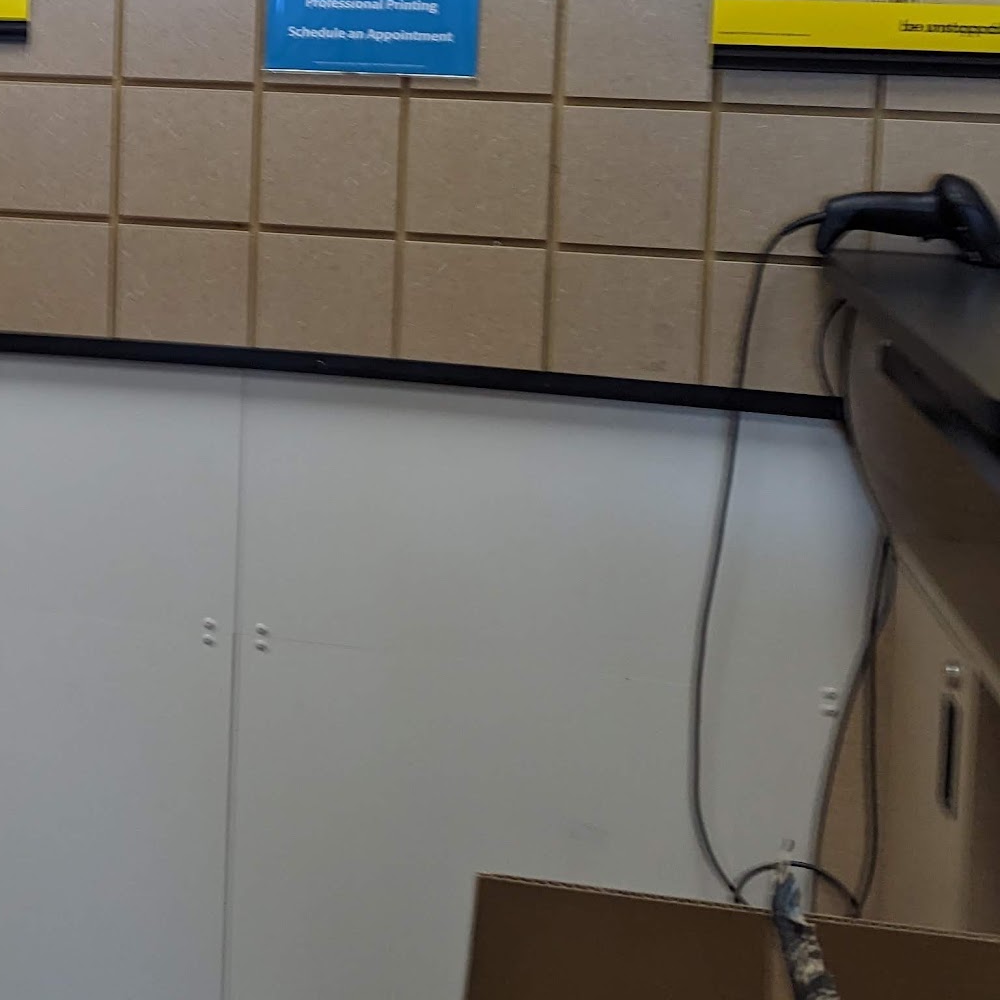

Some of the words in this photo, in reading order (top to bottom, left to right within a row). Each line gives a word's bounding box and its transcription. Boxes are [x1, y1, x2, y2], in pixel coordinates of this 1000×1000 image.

[288, 25, 346, 39] Schedule
[347, 30, 365, 39] an
[366, 29, 455, 44] Appointment
